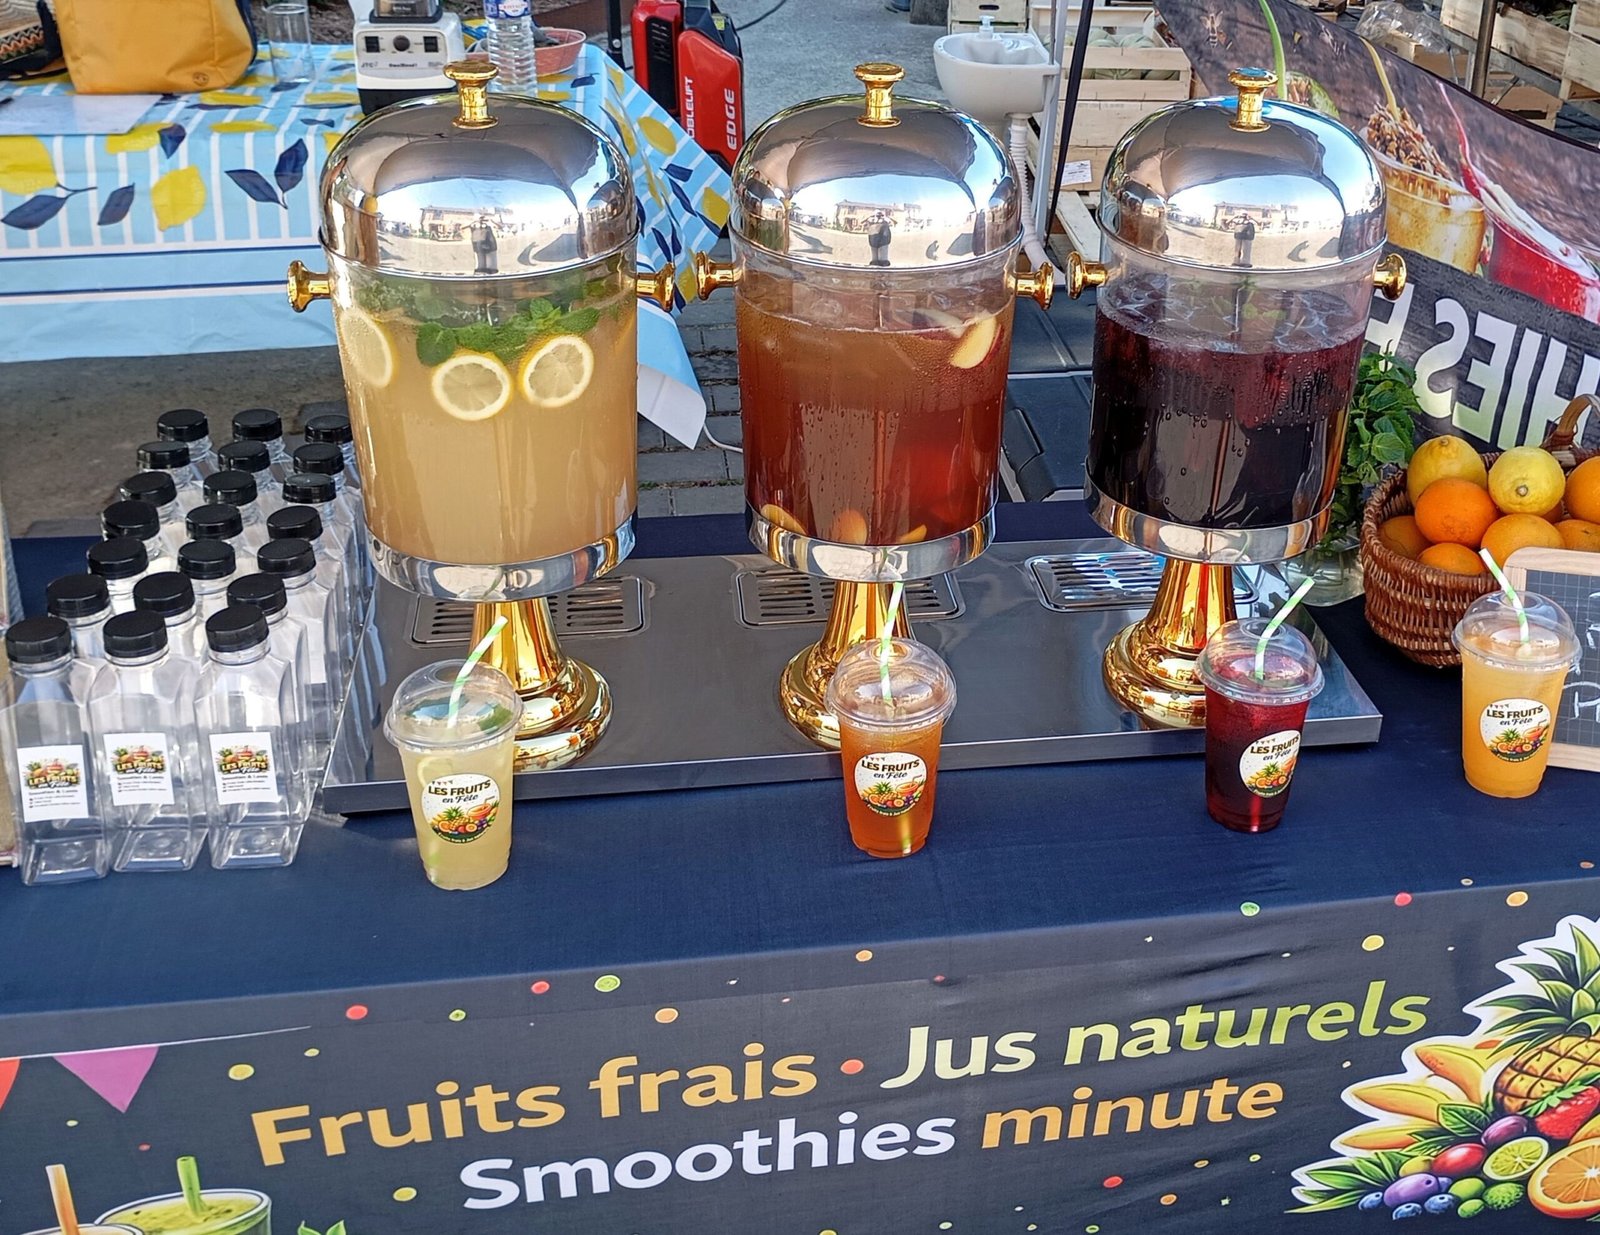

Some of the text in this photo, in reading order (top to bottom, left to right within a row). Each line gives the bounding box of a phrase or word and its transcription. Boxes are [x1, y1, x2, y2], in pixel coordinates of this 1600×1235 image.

[724, 88, 737, 150] EDGE
[1486, 705, 1544, 719] LES FRUITS
[1250, 746, 1270, 754] LES
[861, 759, 920, 772] LES FRUITS
[428, 779, 491, 796] LES FRUITS
[250, 979, 1432, 1167] Fruits frais Jus naturels
[459, 1077, 1284, 1210] Smoothies minute
